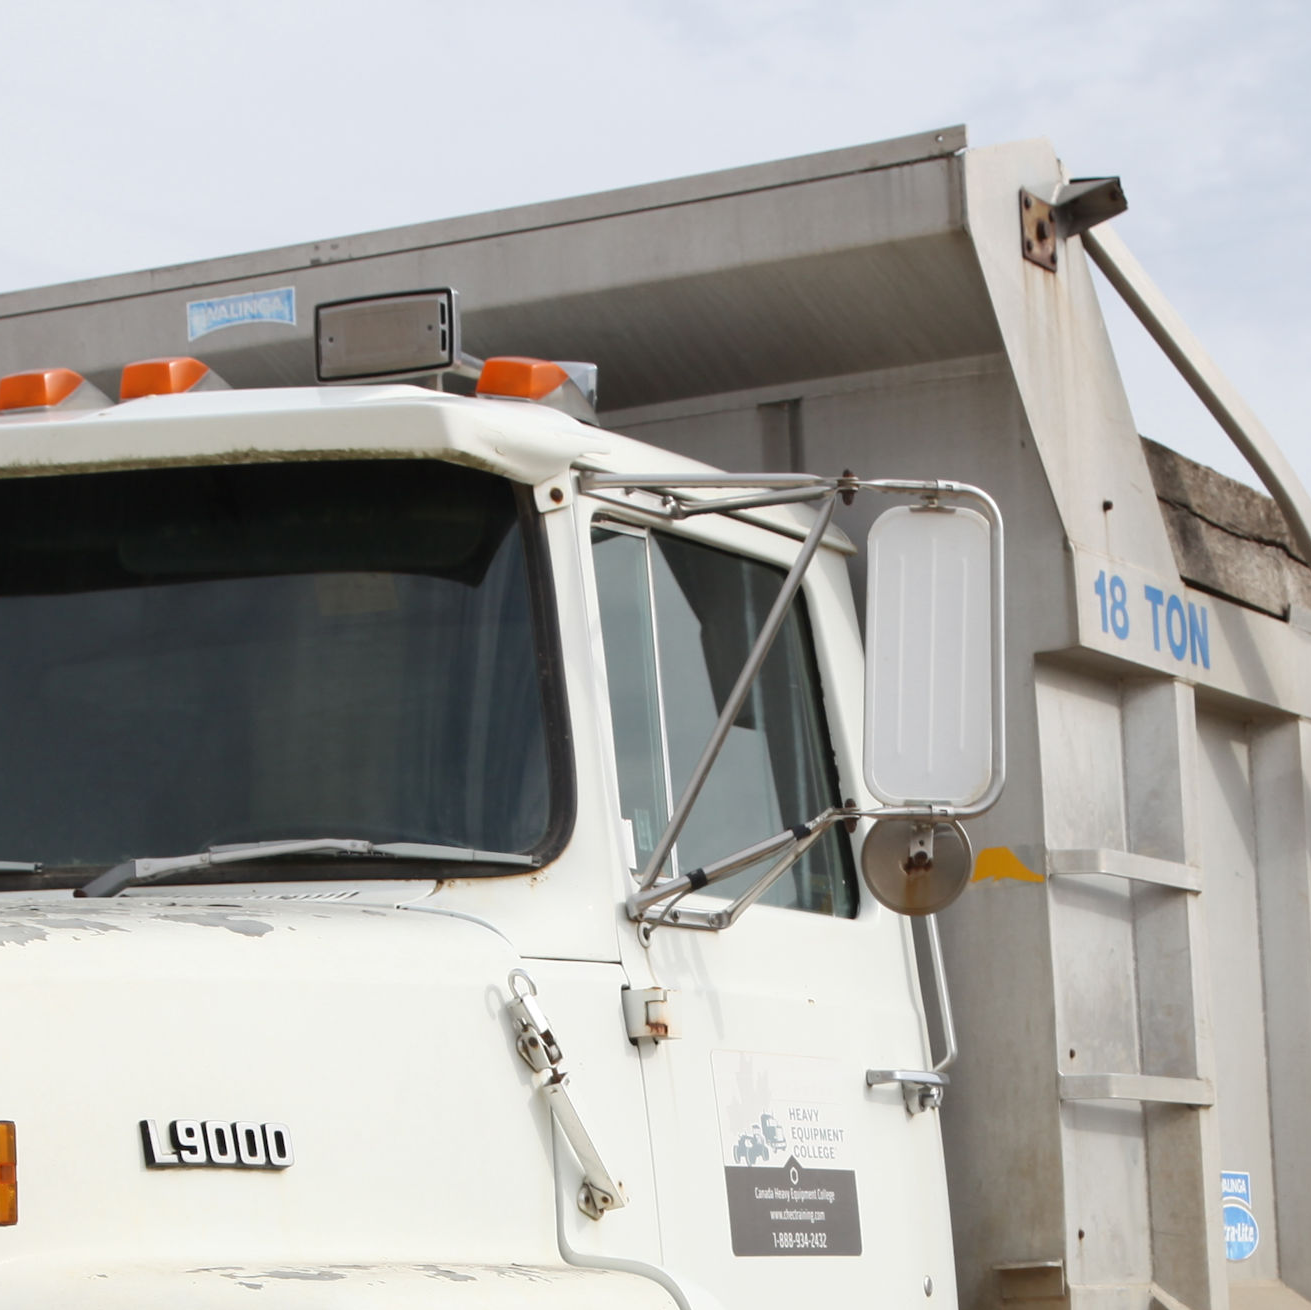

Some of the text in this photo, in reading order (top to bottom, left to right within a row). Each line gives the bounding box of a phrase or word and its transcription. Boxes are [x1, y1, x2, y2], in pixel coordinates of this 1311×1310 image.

[203, 297, 283, 321] WALINGA
[1094, 569, 1210, 669] 18 TON
[789, 1108, 819, 1122] HEAVY
[791, 1127, 844, 1143] EQUIPMENT
[139, 1119, 294, 1170] L9000
[793, 1145, 836, 1159] COLLEGE
[755, 1187, 835, 1204] Canada Heavy Equipment College
[772, 1232, 827, 1248] 1-888-934-2432
